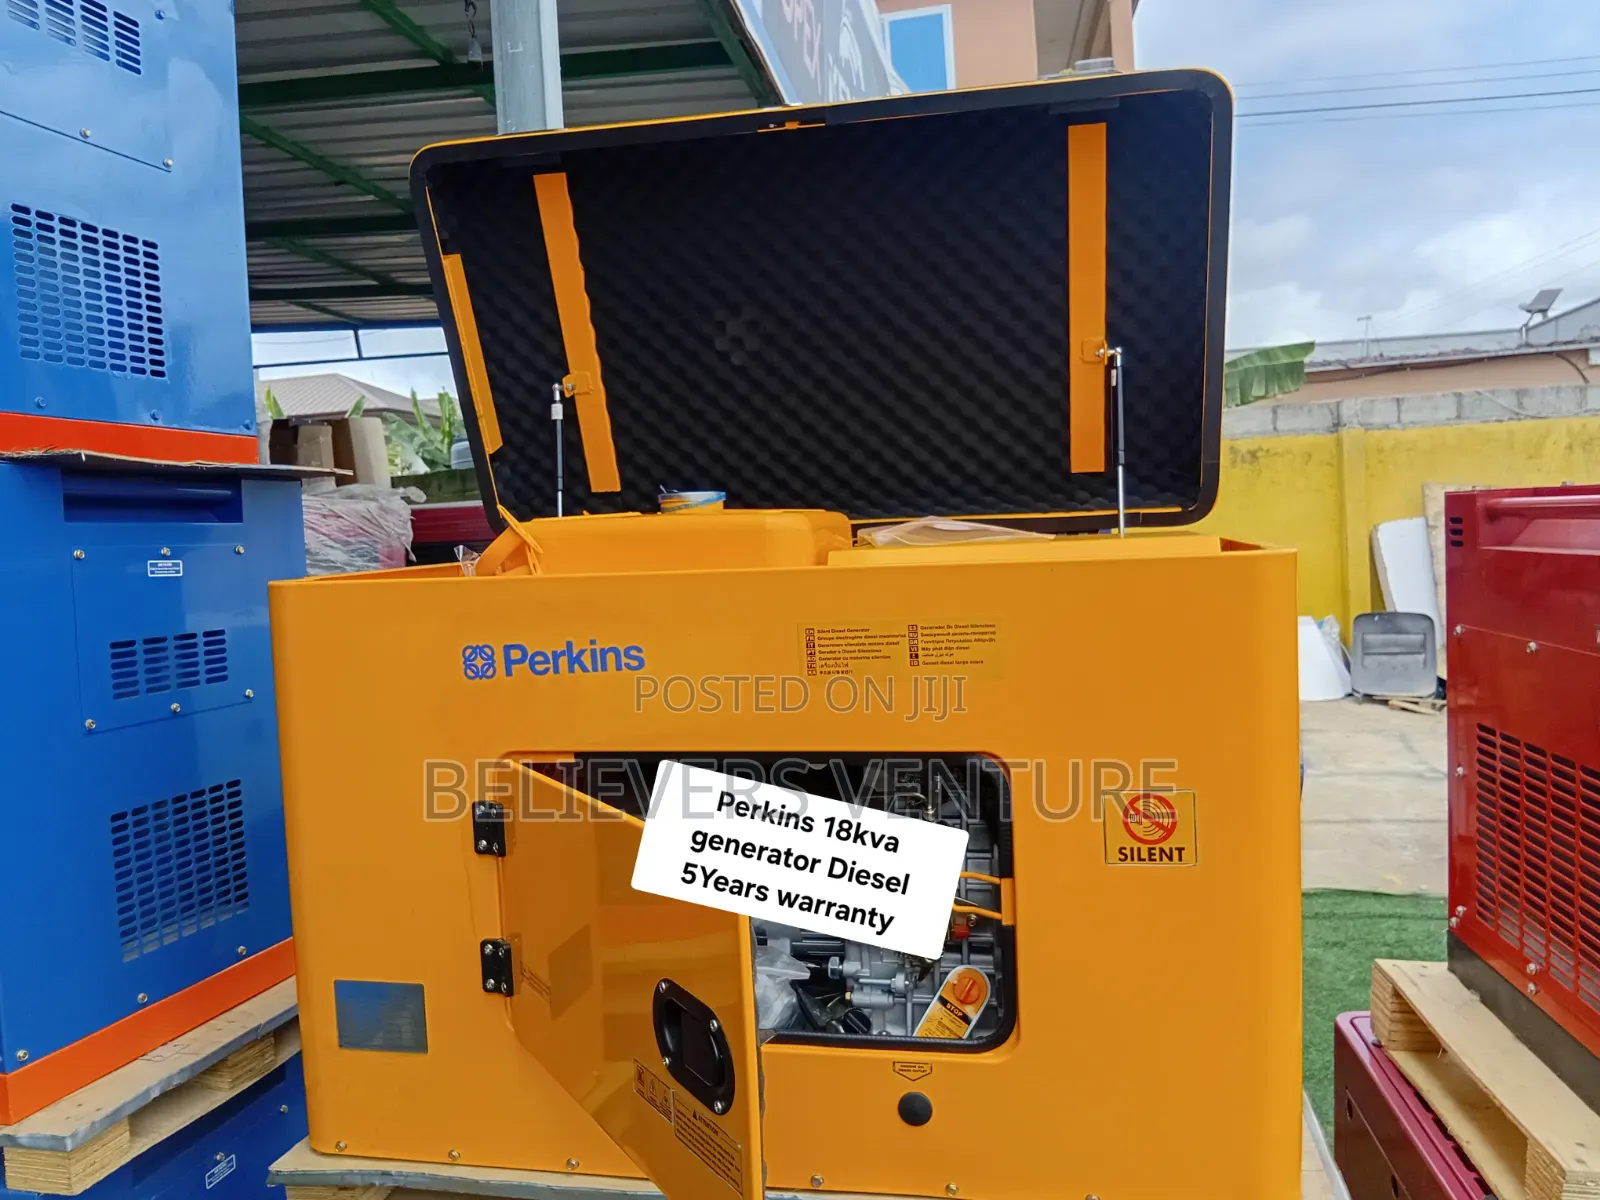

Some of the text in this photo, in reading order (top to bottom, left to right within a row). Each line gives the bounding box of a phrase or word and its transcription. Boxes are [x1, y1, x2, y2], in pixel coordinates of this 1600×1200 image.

[503, 640, 646, 677] Perkins
[1118, 846, 1186, 862] SILENT
[946, 1002, 963, 1017] STOP
